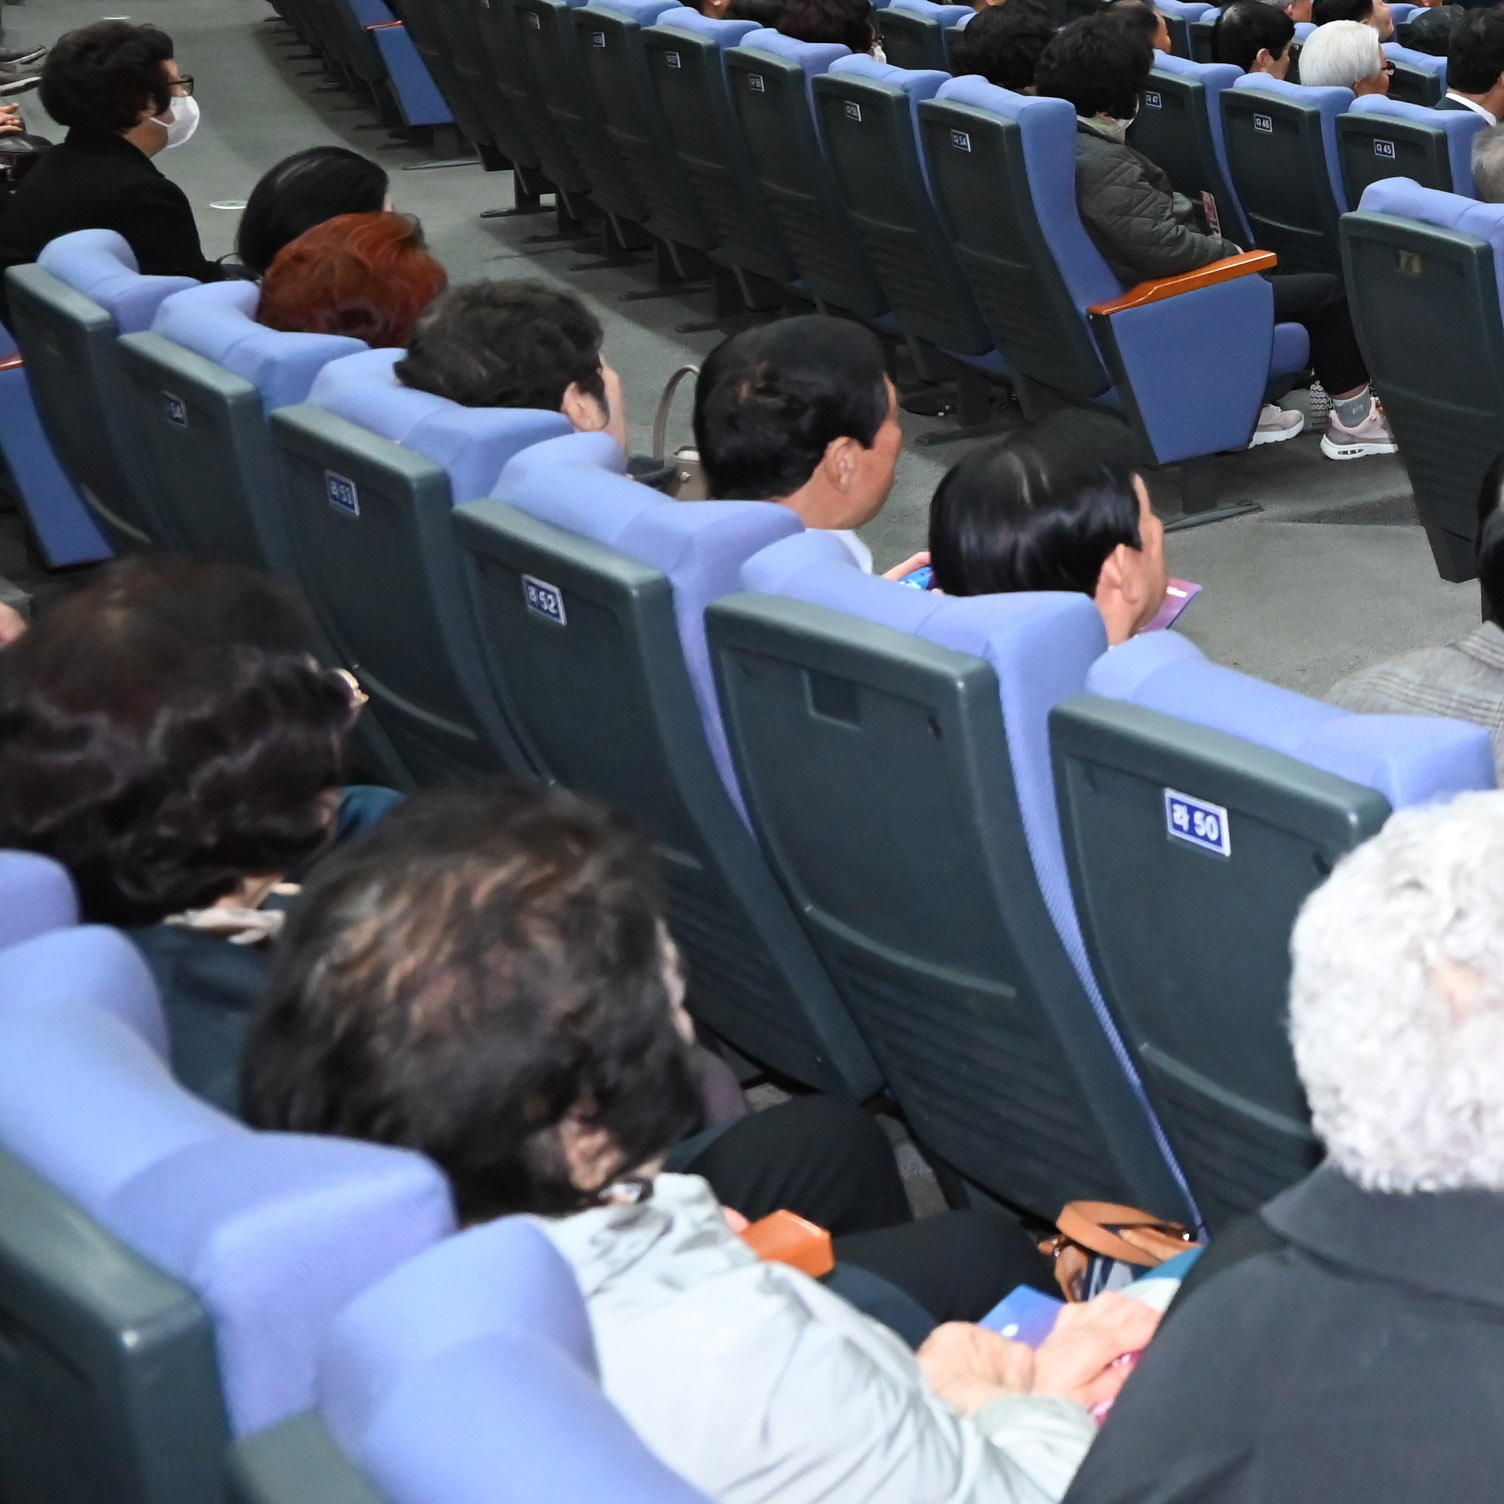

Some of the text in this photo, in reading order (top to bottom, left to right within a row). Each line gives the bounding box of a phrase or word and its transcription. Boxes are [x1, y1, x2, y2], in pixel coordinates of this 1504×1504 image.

[539, 590, 557, 614] 52
[1172, 803, 1219, 841] 라 50
